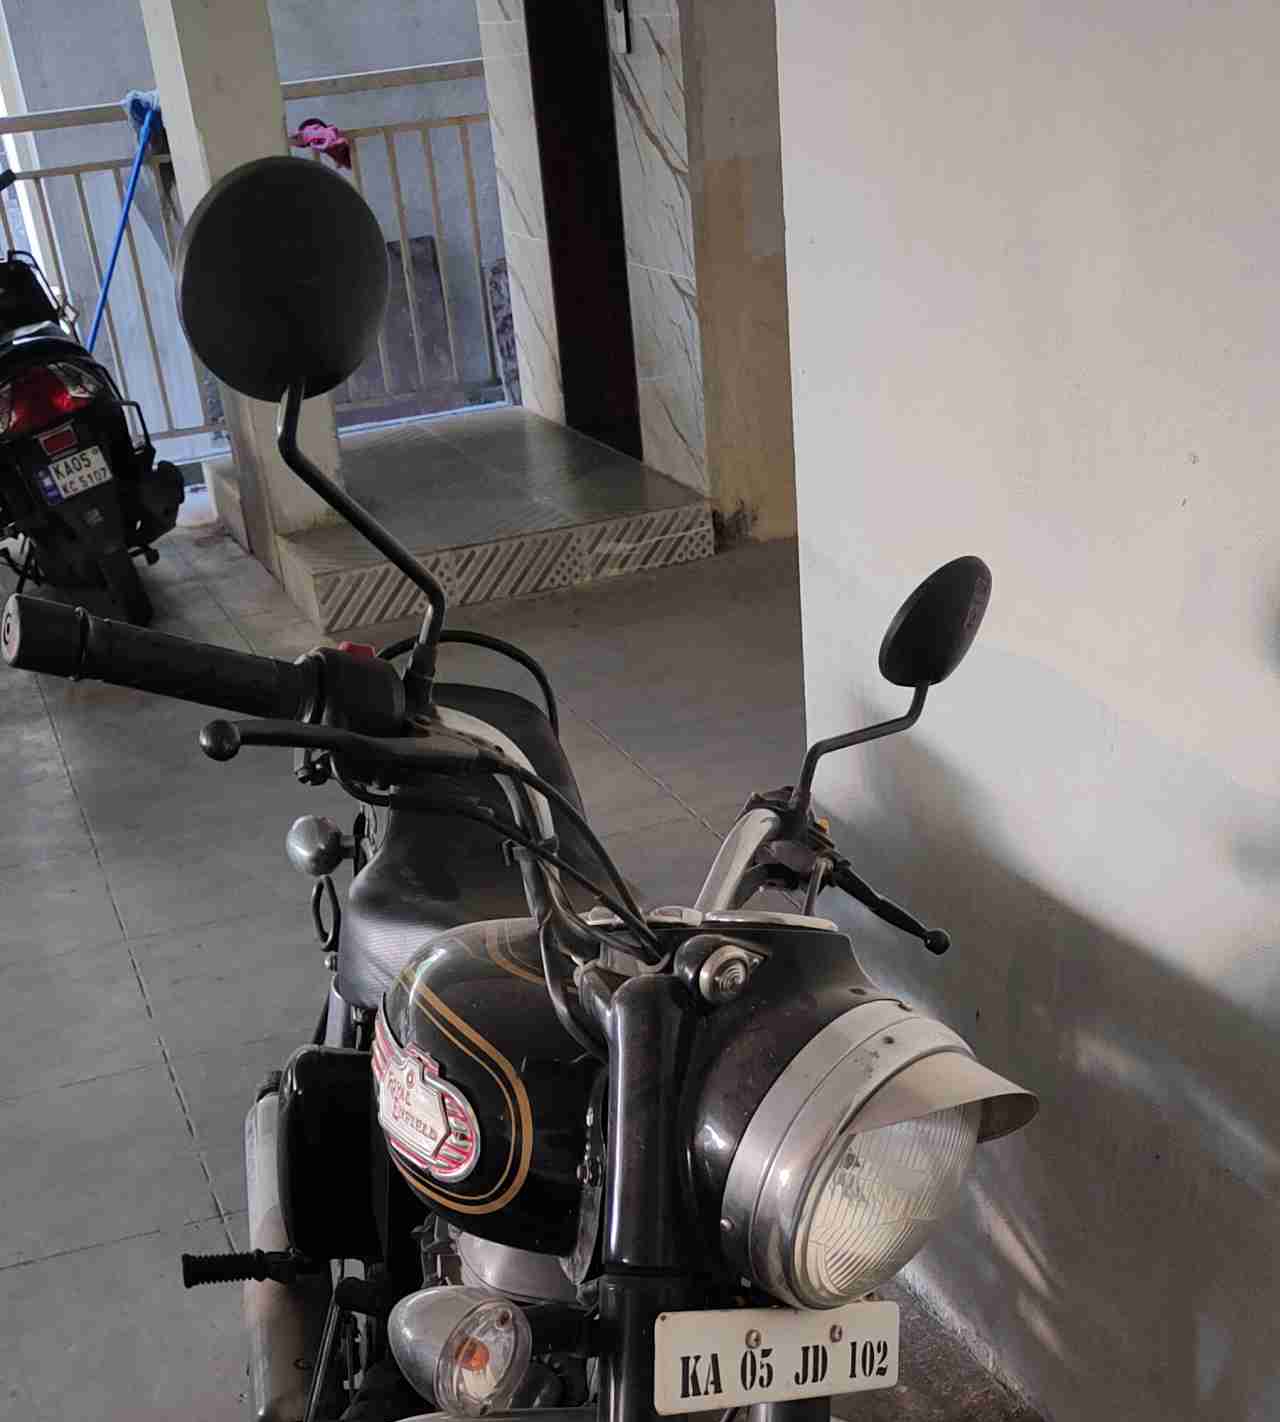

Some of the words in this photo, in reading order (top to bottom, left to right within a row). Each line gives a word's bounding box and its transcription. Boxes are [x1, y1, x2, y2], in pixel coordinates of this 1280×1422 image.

[53, 452, 92, 480] KA05
[680, 1353, 723, 1399] KA
[740, 1348, 774, 1391] 05
[794, 1344, 829, 1385] JD
[848, 1340, 889, 1379] 102
